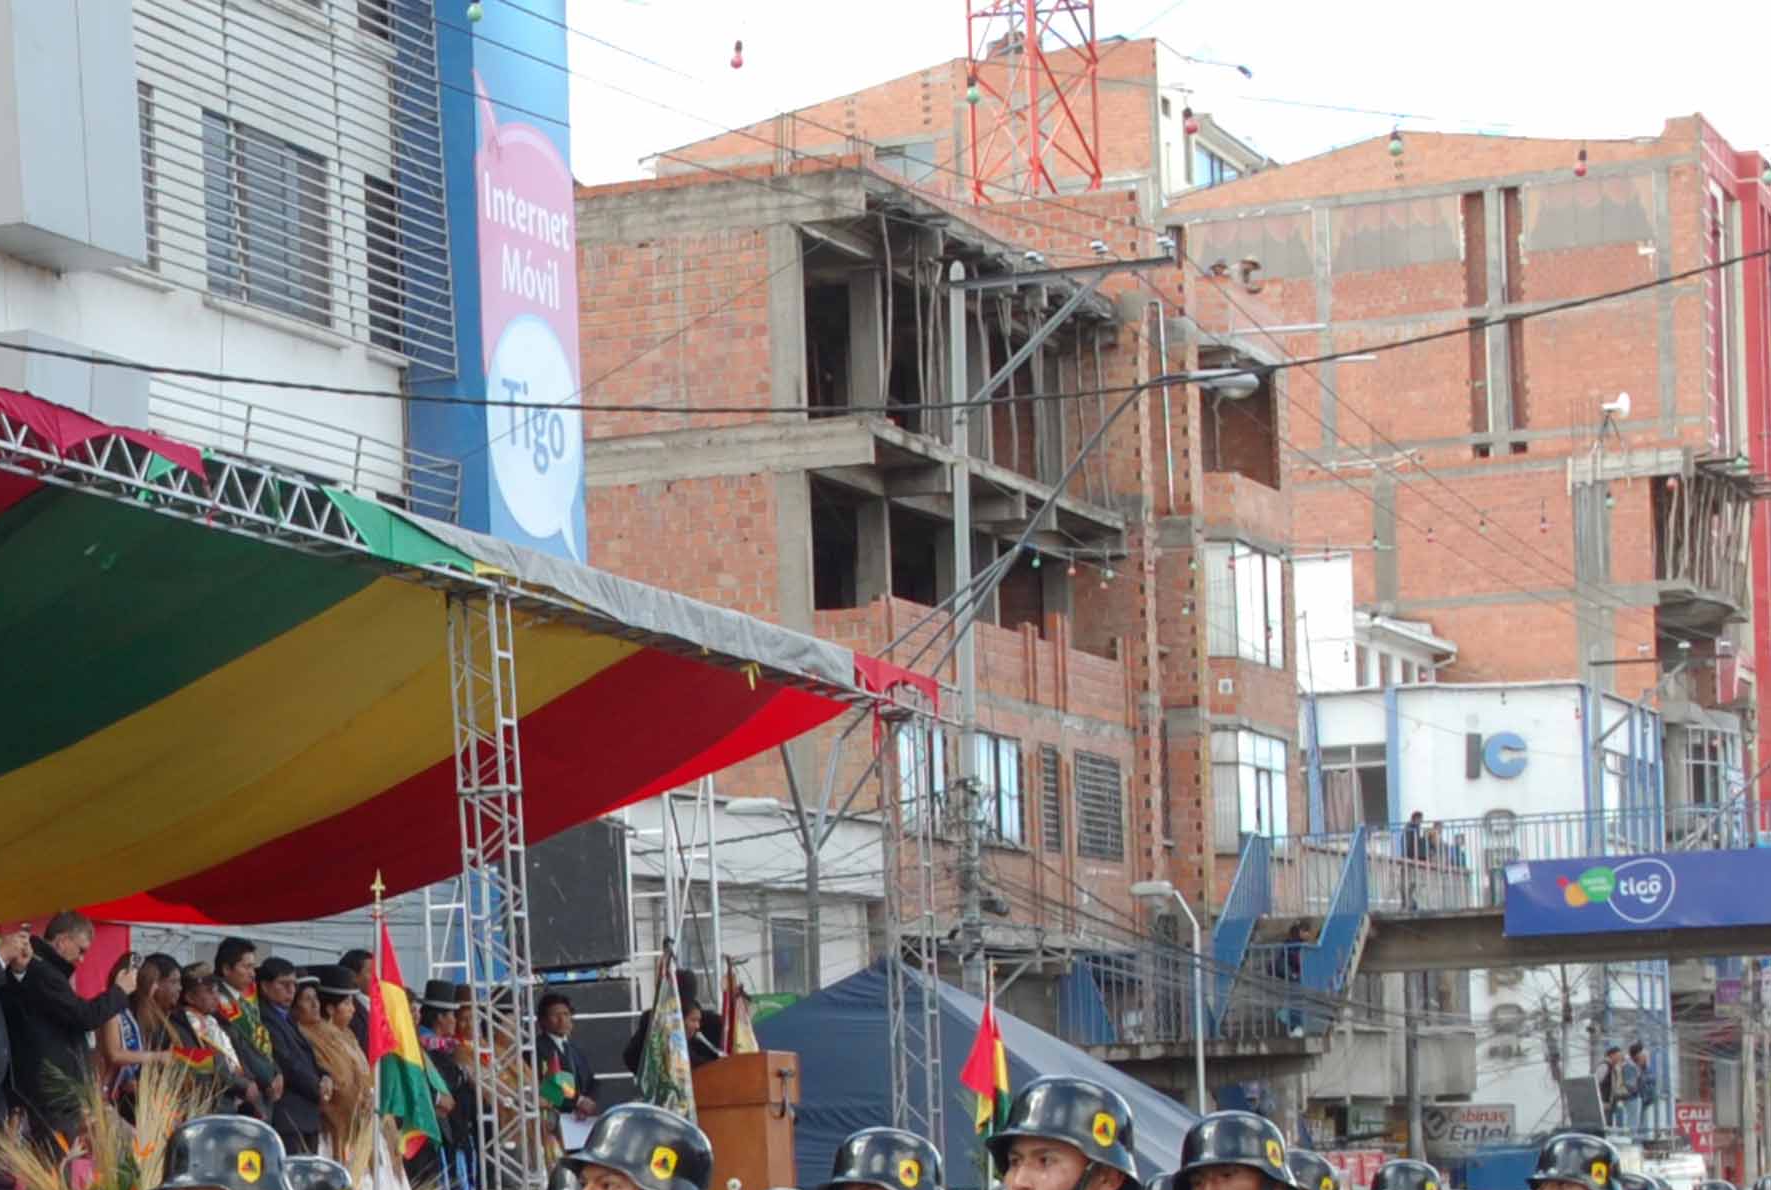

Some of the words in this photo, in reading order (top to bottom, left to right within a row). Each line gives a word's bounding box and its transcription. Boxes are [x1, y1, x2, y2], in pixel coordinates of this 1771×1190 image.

[483, 171, 571, 252] Internet
[500, 246, 561, 311] Móvil
[501, 377, 565, 476] Tigo
[1450, 1125, 1511, 1142] Entel
